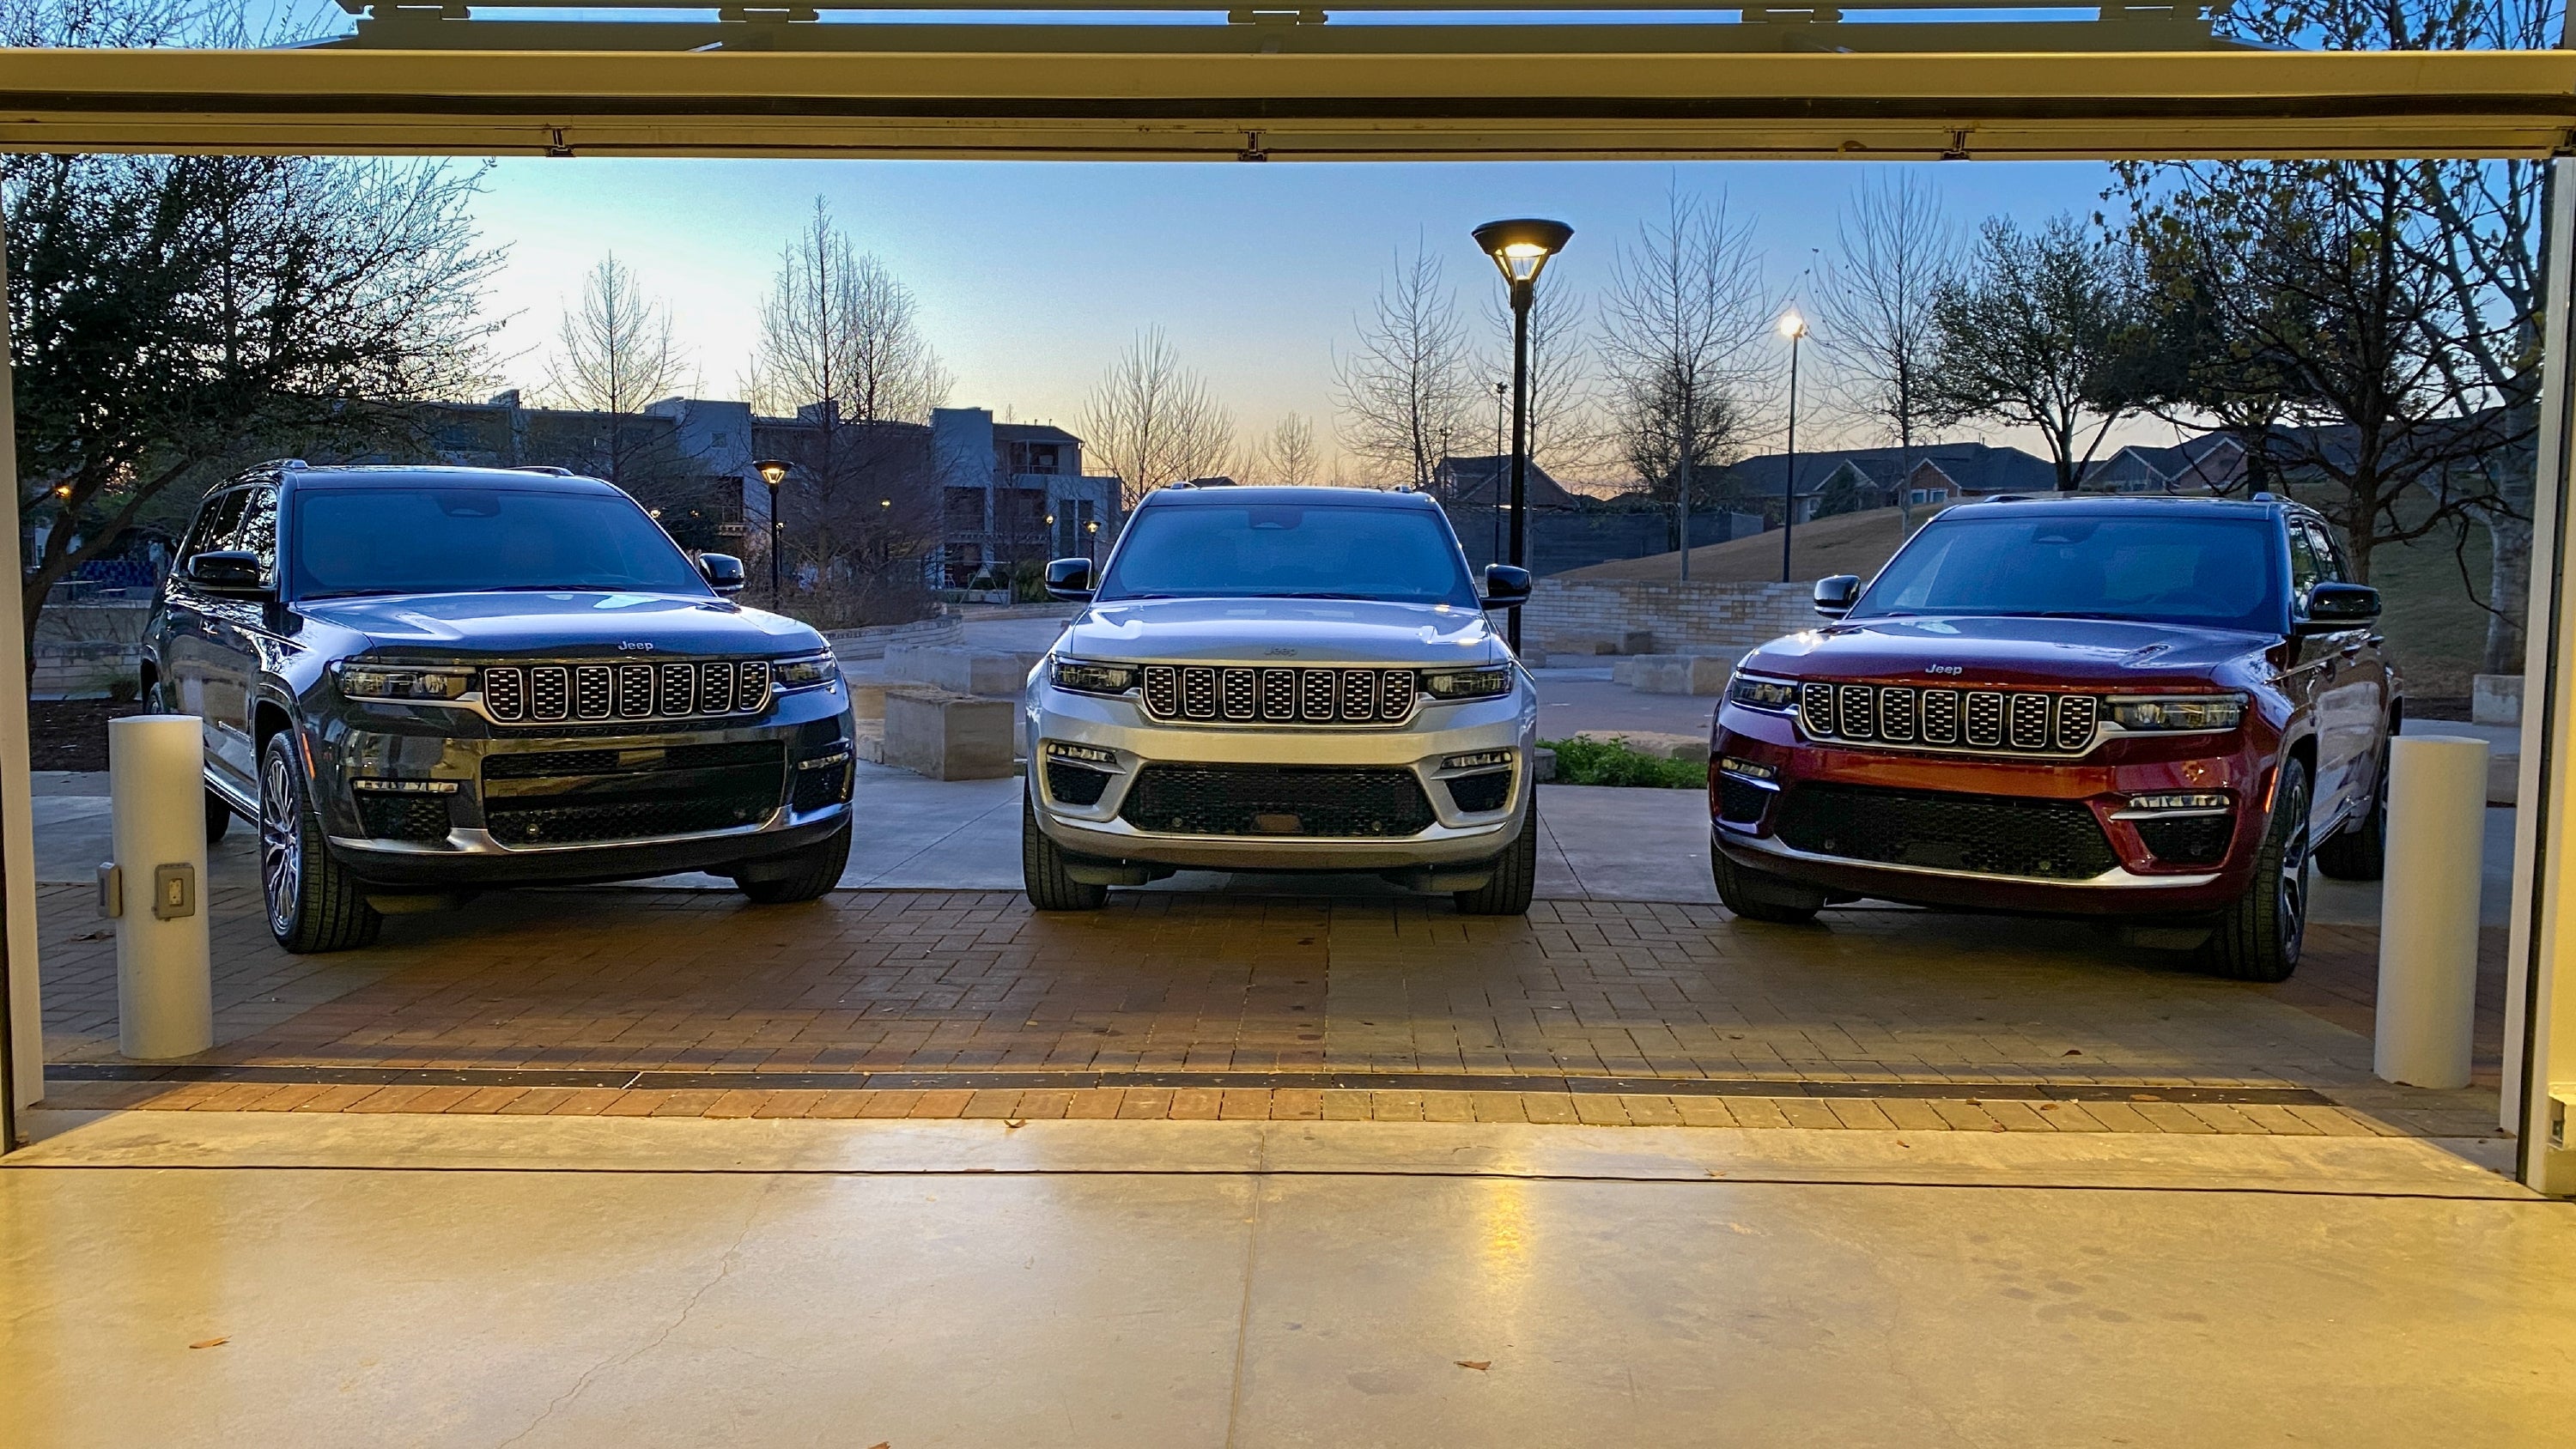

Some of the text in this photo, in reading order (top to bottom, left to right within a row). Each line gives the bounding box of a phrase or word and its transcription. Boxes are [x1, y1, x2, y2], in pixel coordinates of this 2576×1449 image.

[618, 640, 653, 652] Jeep
[1264, 646, 1297, 658] Jeep
[1925, 664, 1963, 676] Jeep
